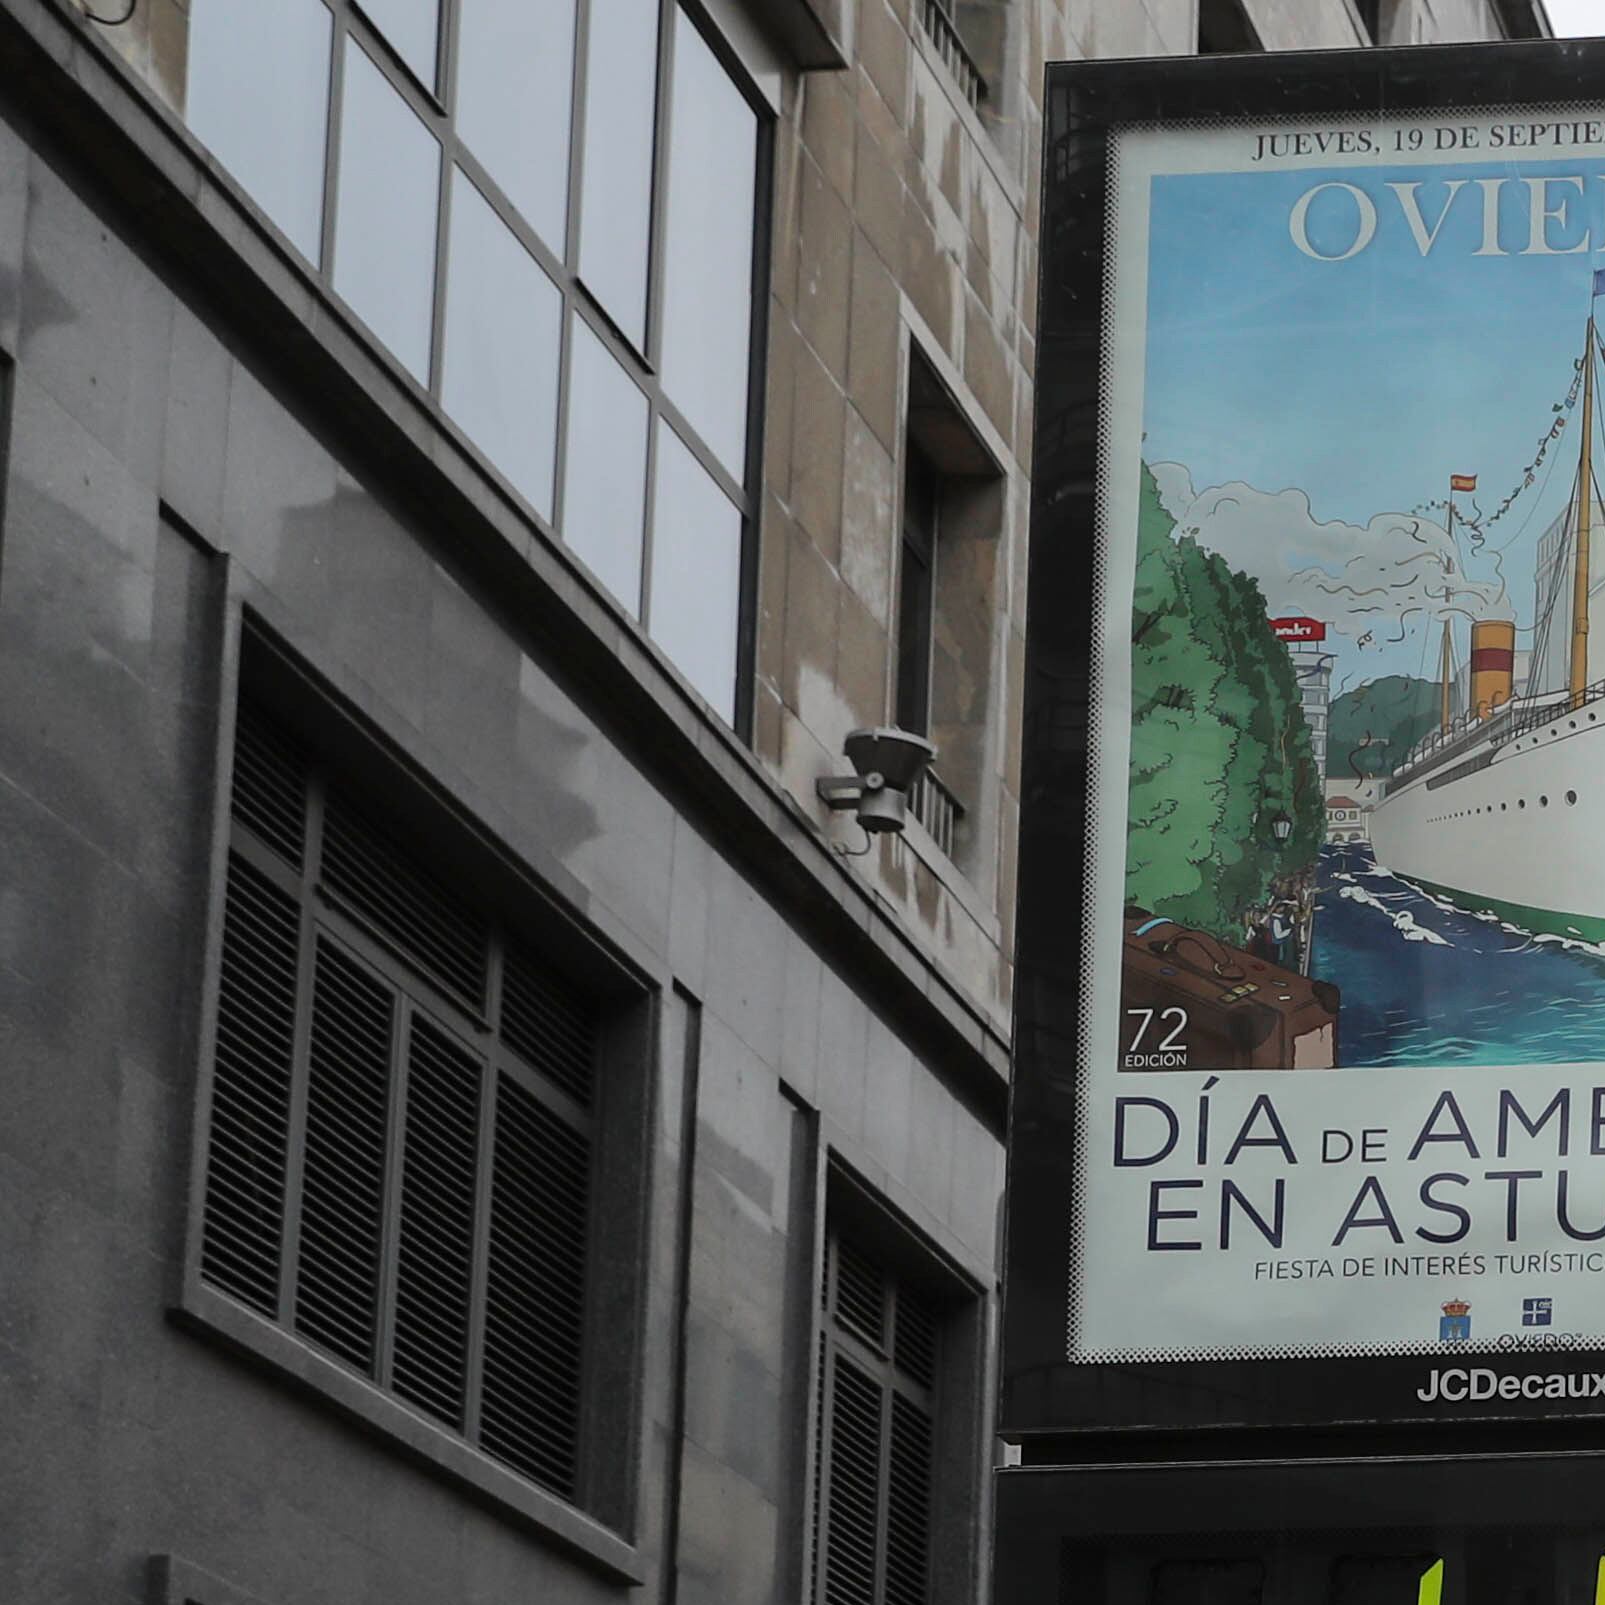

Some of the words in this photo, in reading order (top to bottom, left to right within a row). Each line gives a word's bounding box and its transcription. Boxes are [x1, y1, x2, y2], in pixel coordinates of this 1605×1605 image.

[1252, 129, 1381, 161] JUEVES,
[1394, 127, 1424, 151] 19
[1434, 125, 1480, 150] DE
[1126, 1007, 1188, 1052] 72
[1124, 1051, 1187, 1067] EDICIÓN
[1113, 1075, 1298, 1167] DÍA
[1321, 1128, 1388, 1163] DE
[1147, 1178, 1285, 1251] EN
[1255, 1259, 1334, 1280] FIESTA
[1342, 1257, 1376, 1278] DE
[1384, 1252, 1486, 1277] INTERÉS
